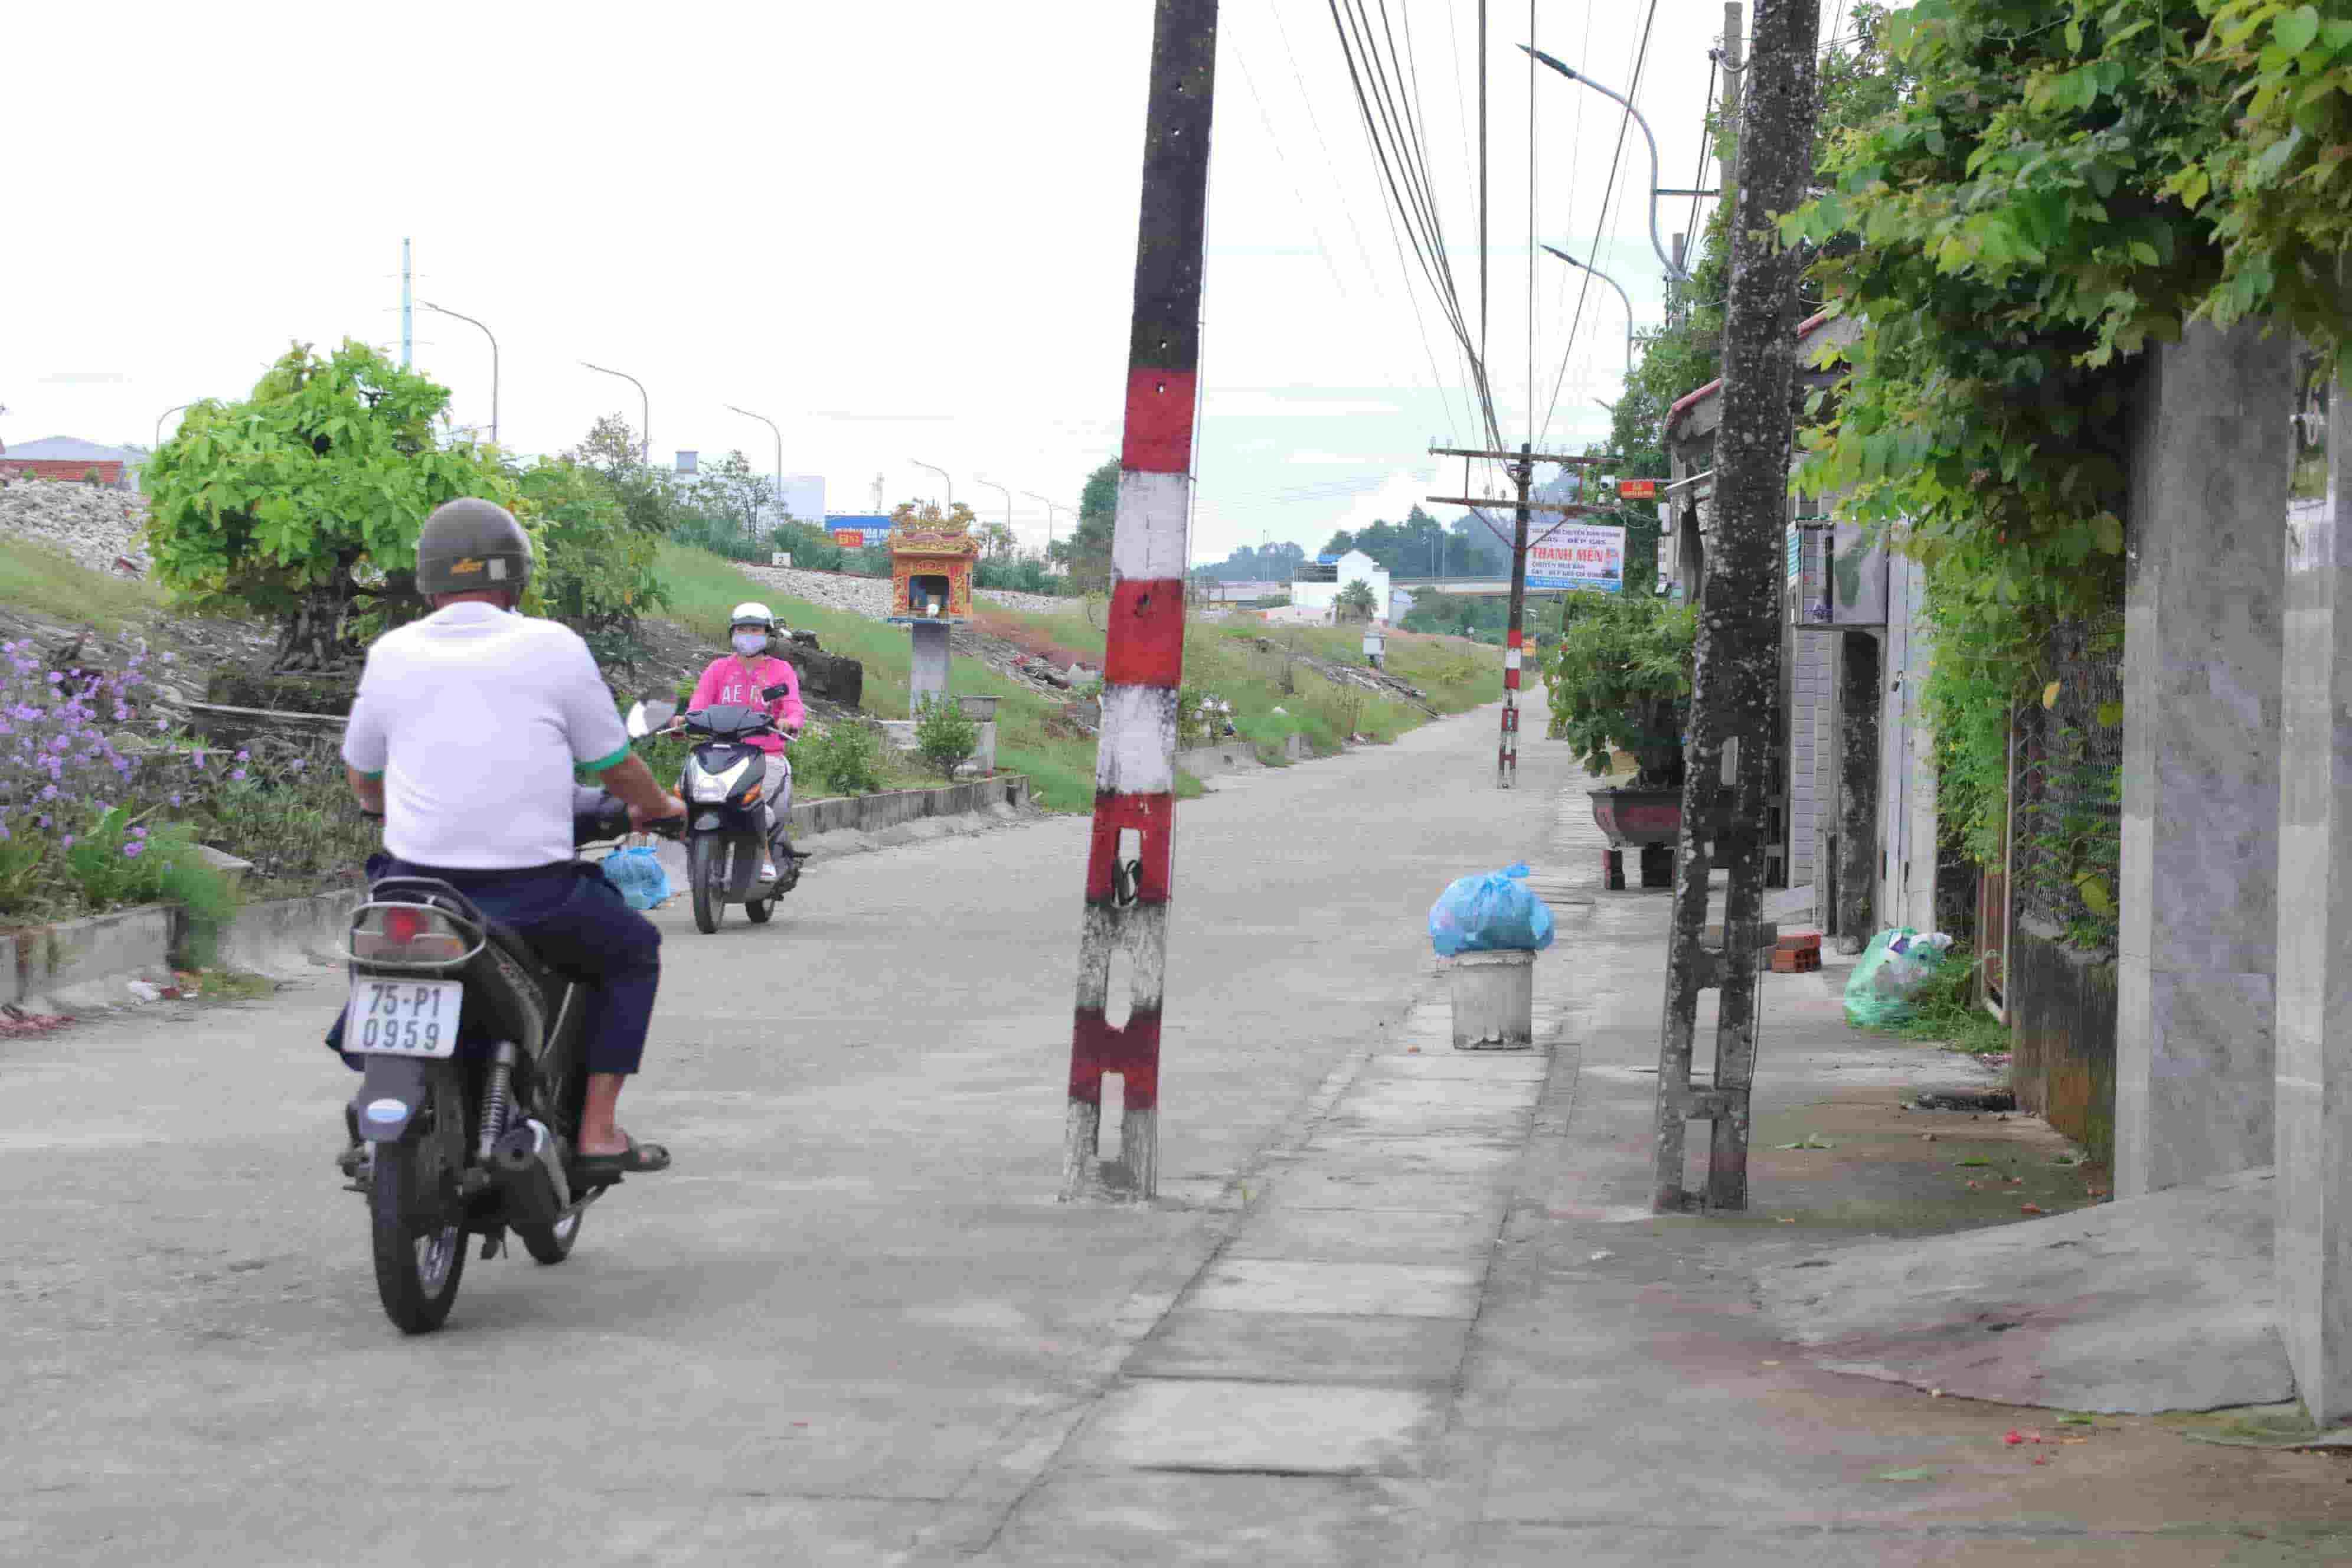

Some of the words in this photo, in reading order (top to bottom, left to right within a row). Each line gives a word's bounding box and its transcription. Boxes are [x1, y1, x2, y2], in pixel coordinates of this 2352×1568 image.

[1532, 547, 1573, 560] THANH
[370, 984, 441, 1018] 75-P1
[362, 1018, 440, 1051] 0959
